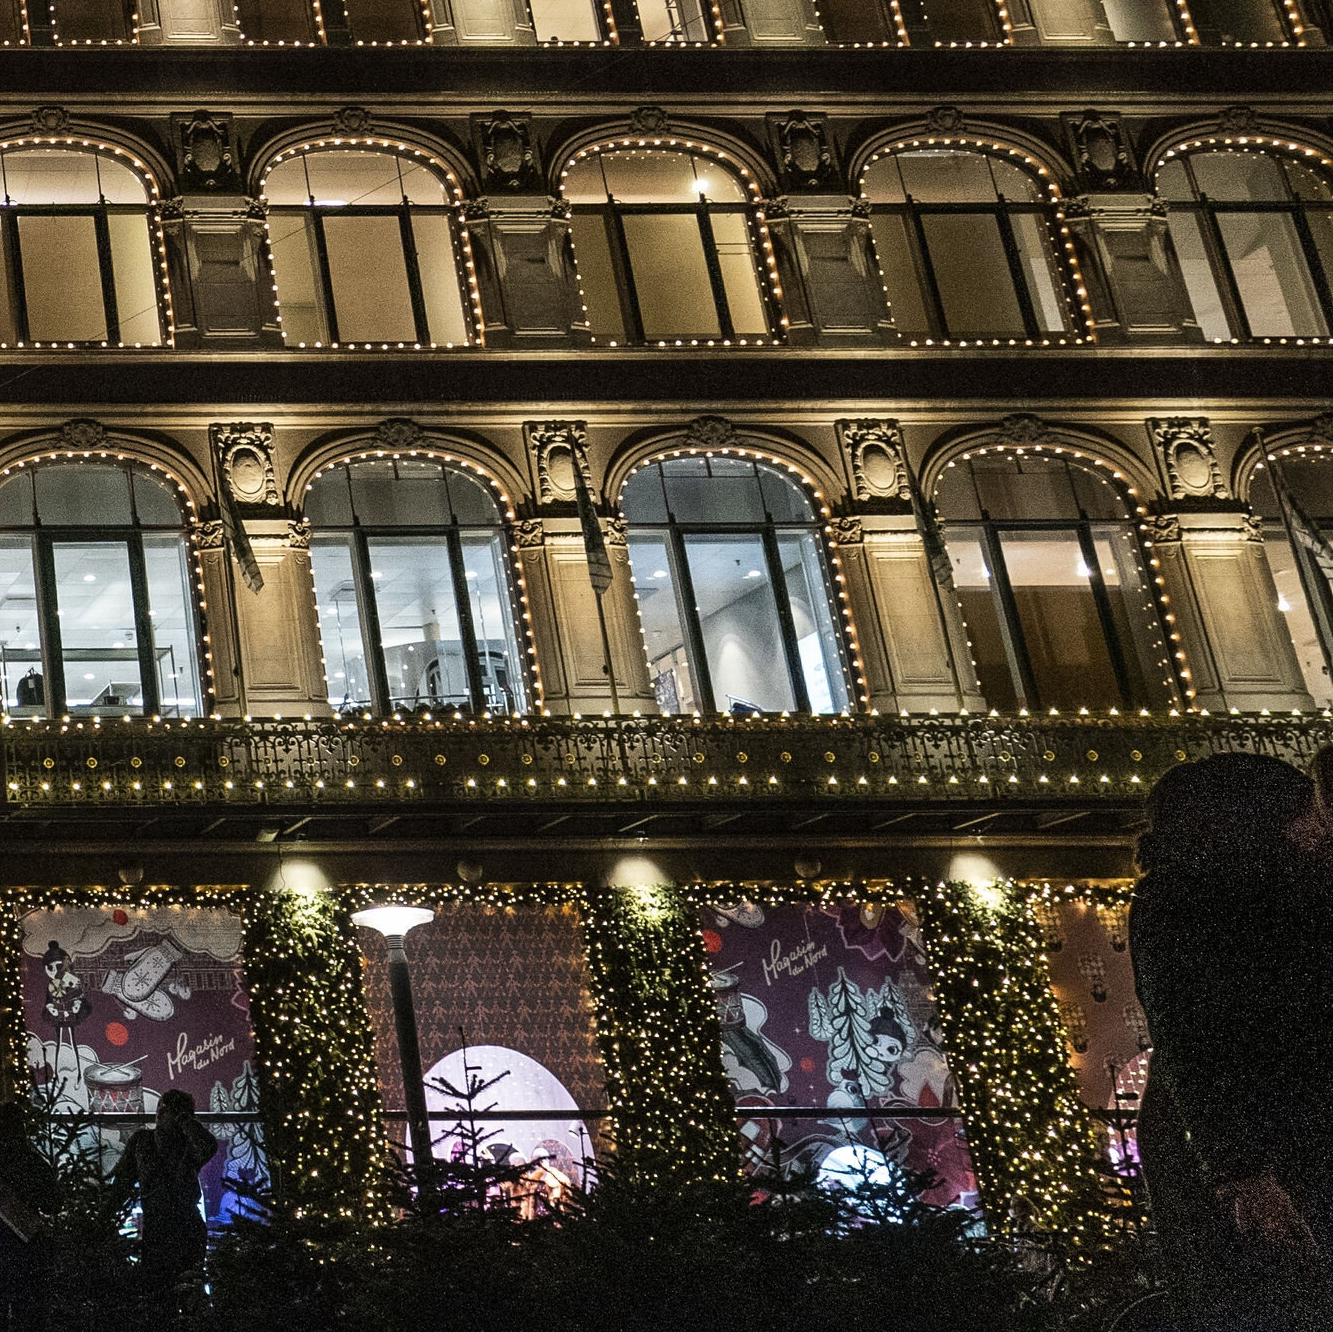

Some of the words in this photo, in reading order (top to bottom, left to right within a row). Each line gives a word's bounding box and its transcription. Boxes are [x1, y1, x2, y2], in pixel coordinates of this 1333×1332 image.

[762, 938, 815, 987] Magasin
[804, 943, 828, 969] Nord
[166, 1031, 223, 1081] Magasin
[210, 1037, 235, 1062] Nord
